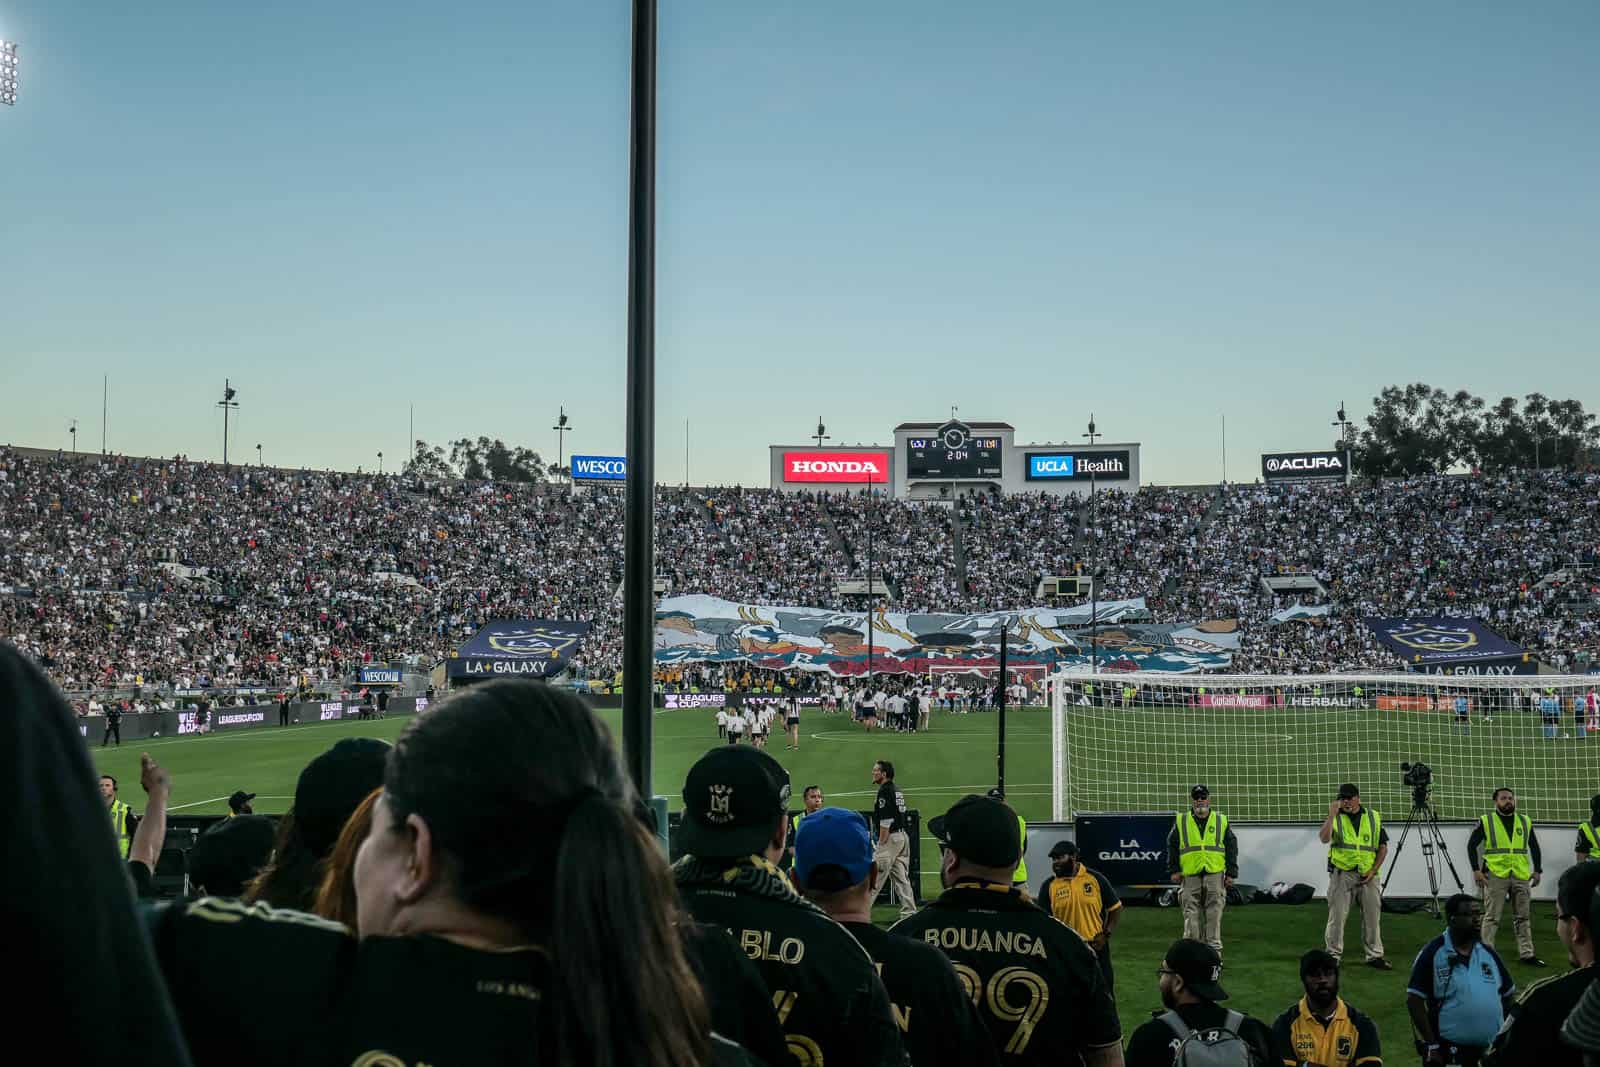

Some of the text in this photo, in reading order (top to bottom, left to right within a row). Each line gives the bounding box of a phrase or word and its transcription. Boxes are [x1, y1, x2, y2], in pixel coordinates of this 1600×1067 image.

[947, 450, 968, 460] 2:04
[576, 460, 626, 474] WESCO
[792, 461, 880, 473] HONDA
[1036, 459, 1123, 472] UCLA Health
[1280, 457, 1342, 470] ACURA
[465, 661, 547, 673] LA GALAXY
[364, 671, 392, 682] WESCOM
[1120, 839, 1140, 848] LA
[1098, 851, 1162, 861] GALAXY
[924, 927, 1048, 960] BOUANGA
